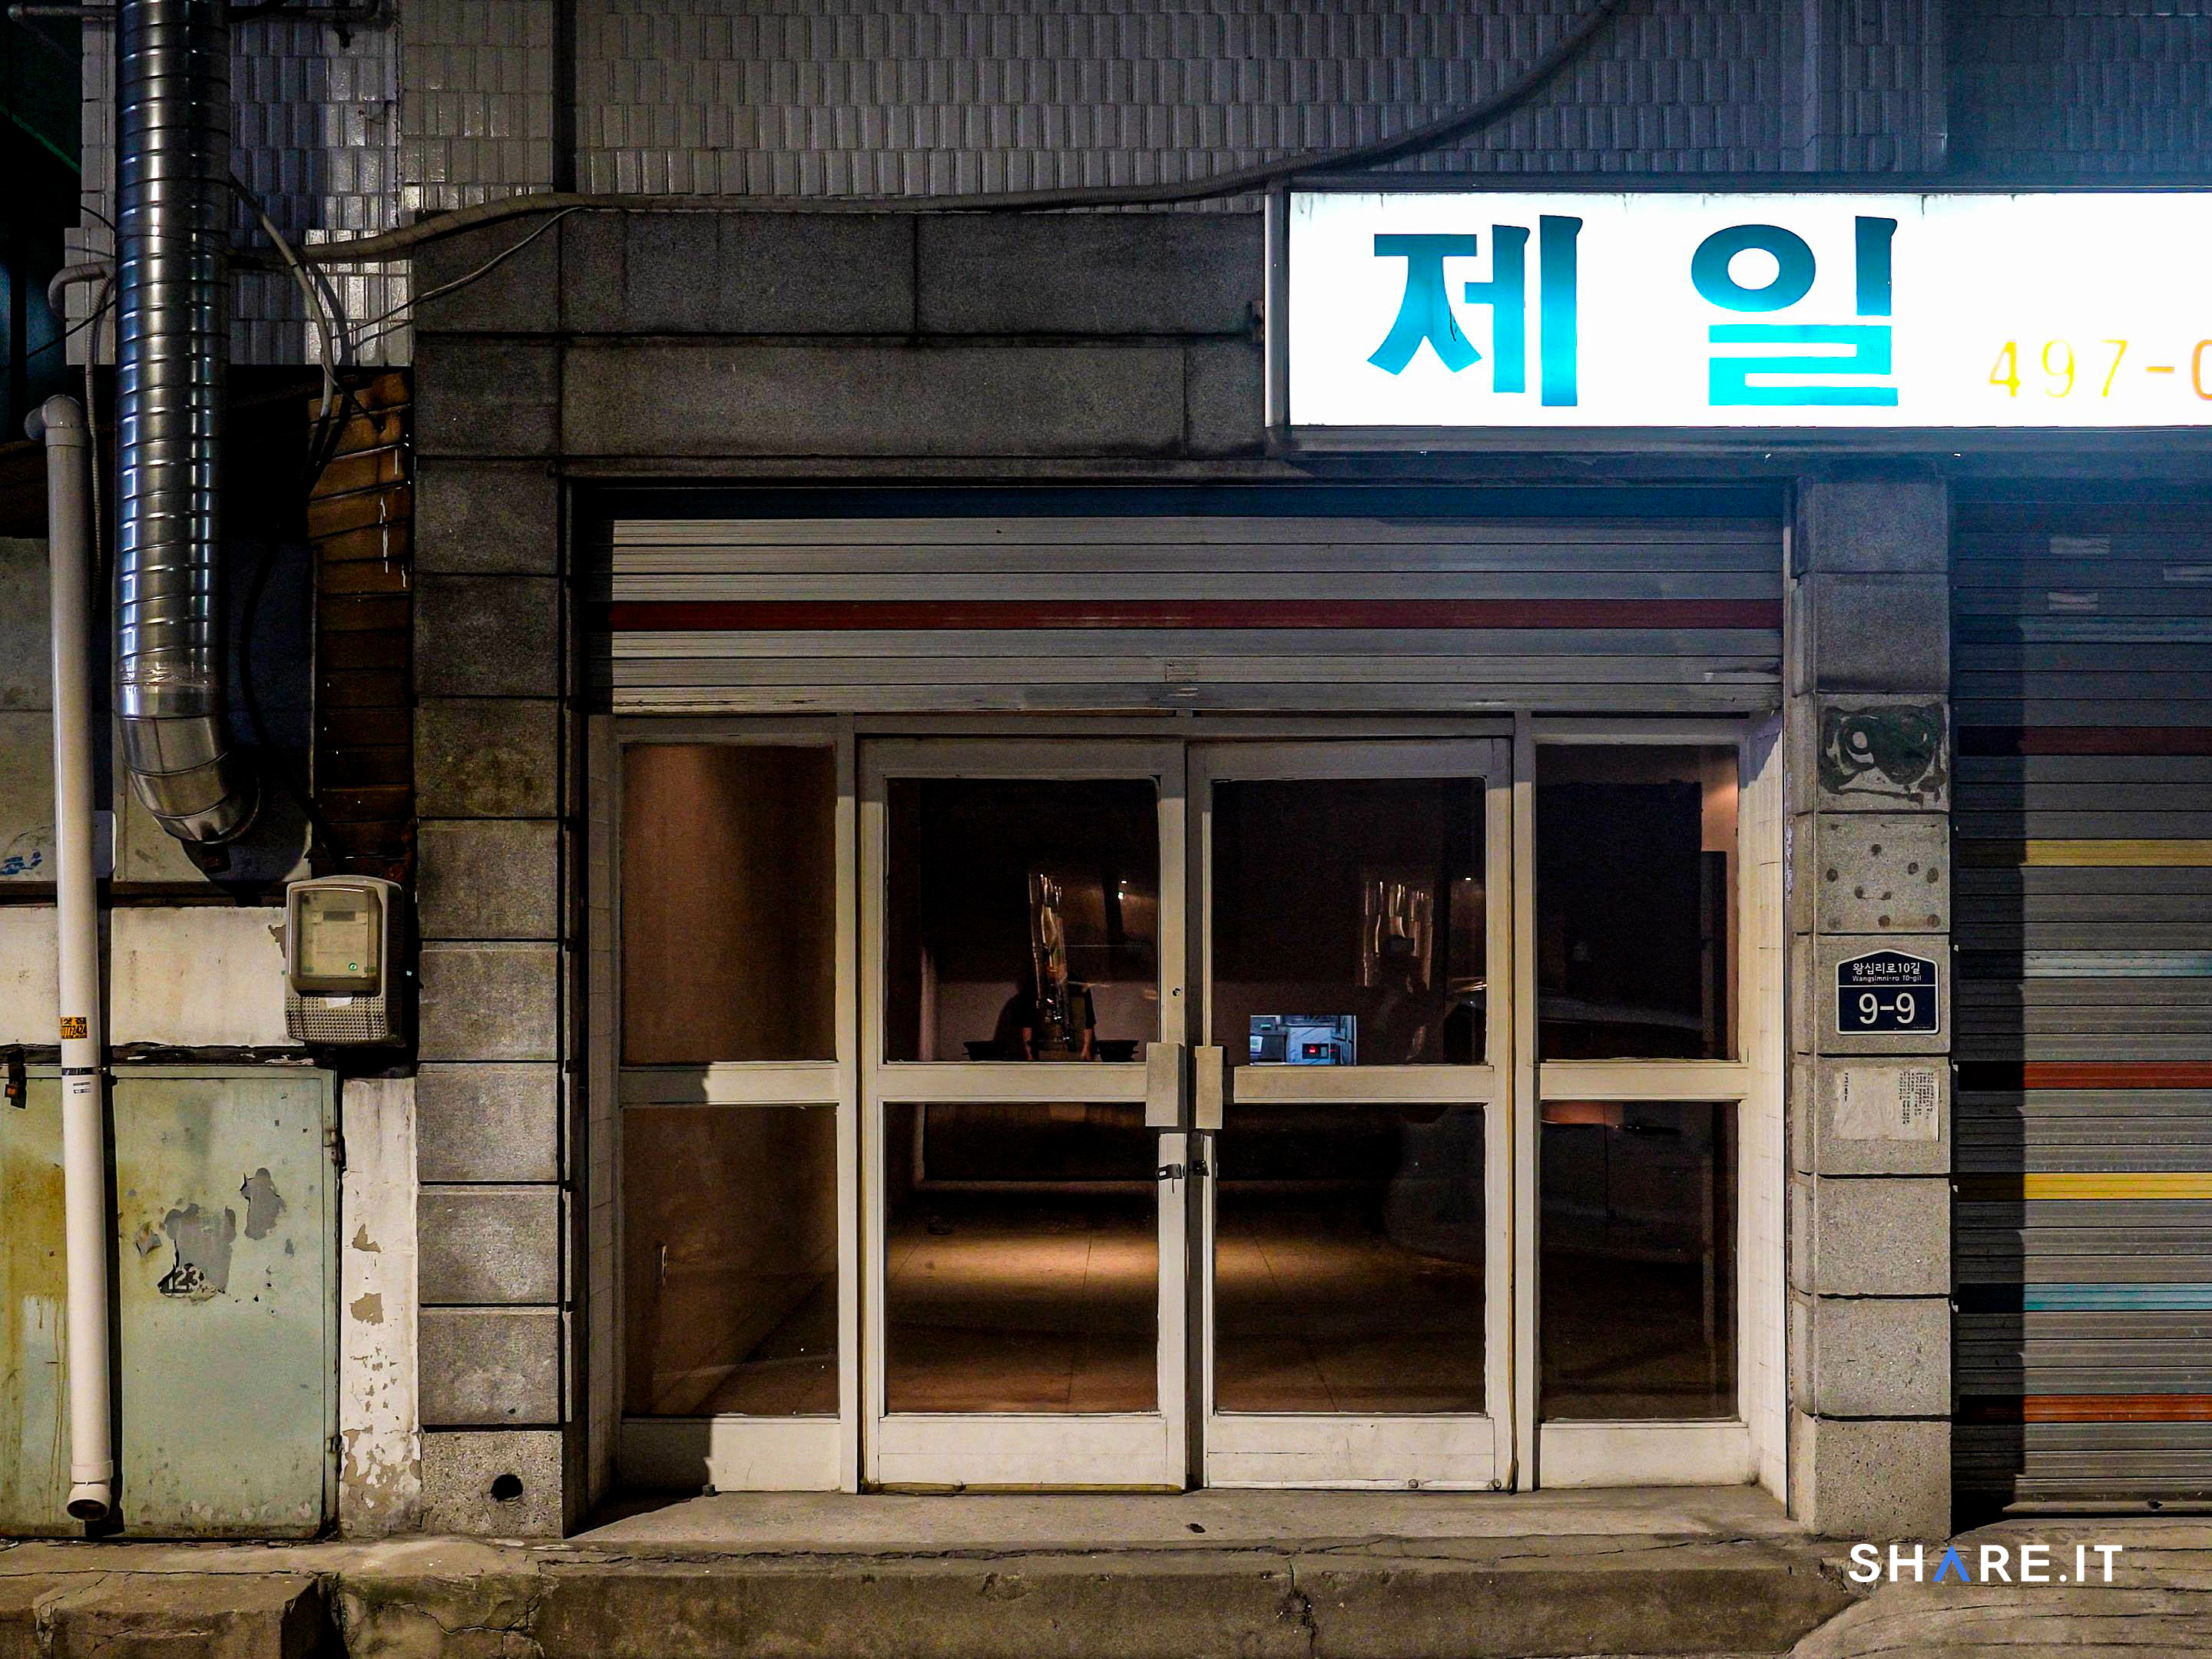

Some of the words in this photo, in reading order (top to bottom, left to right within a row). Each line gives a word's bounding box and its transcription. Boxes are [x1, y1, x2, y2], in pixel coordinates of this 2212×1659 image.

[1853, 962, 1921, 975] 왕십리로10길
[1852, 975, 1899, 983] Wangsimni-ro
[1859, 992, 1916, 1025] 9-9
